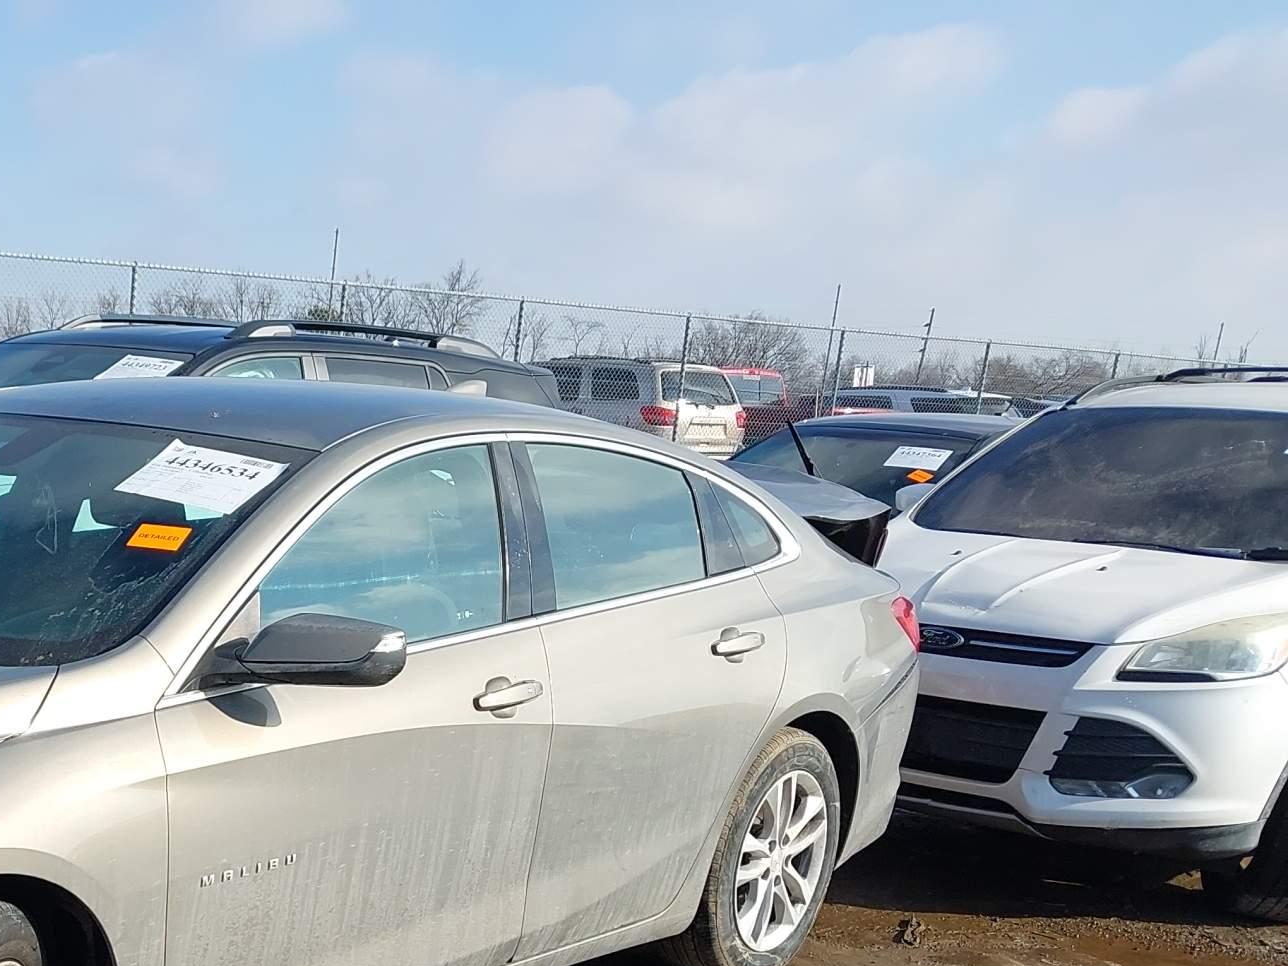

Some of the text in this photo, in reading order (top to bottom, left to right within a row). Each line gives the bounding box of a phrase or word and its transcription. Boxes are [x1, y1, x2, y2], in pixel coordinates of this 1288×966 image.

[165, 456, 261, 480] 44346534
[138, 532, 181, 542] DETAILED
[199, 853, 297, 888] MALIBU
